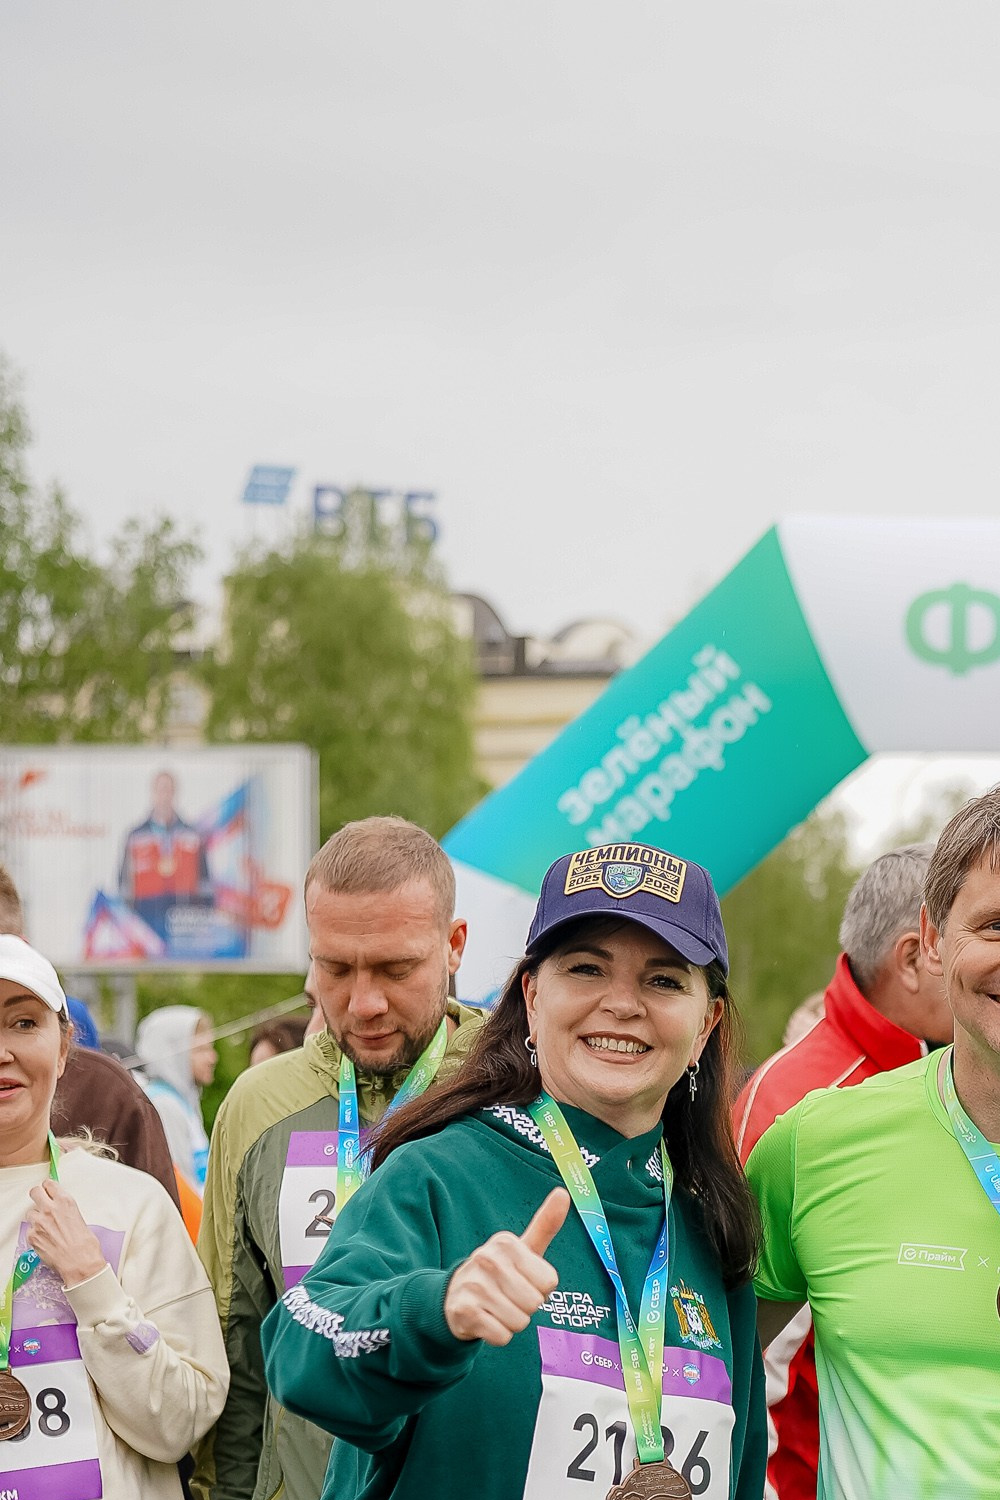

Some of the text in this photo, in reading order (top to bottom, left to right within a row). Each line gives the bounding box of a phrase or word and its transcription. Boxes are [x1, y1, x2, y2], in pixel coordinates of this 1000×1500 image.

[314, 484, 437, 546] ВТБ
[556, 643, 741, 827] зелёный
[574, 845, 684, 876] ЧЕМПИОНЫ
[568, 873, 600, 888] 2025
[645, 877, 679, 896] 2026
[542, 1110, 557, 1128] 185
[918, 1248, 957, 1264] Прайм
[650, 1278, 662, 1309] СБЕР
[538, 1301, 612, 1319] ЫБИРАЕТ
[550, 1312, 602, 1329] СПОРТ
[593, 1355, 613, 1369] СБЕР
[630, 1347, 642, 1369] 185
